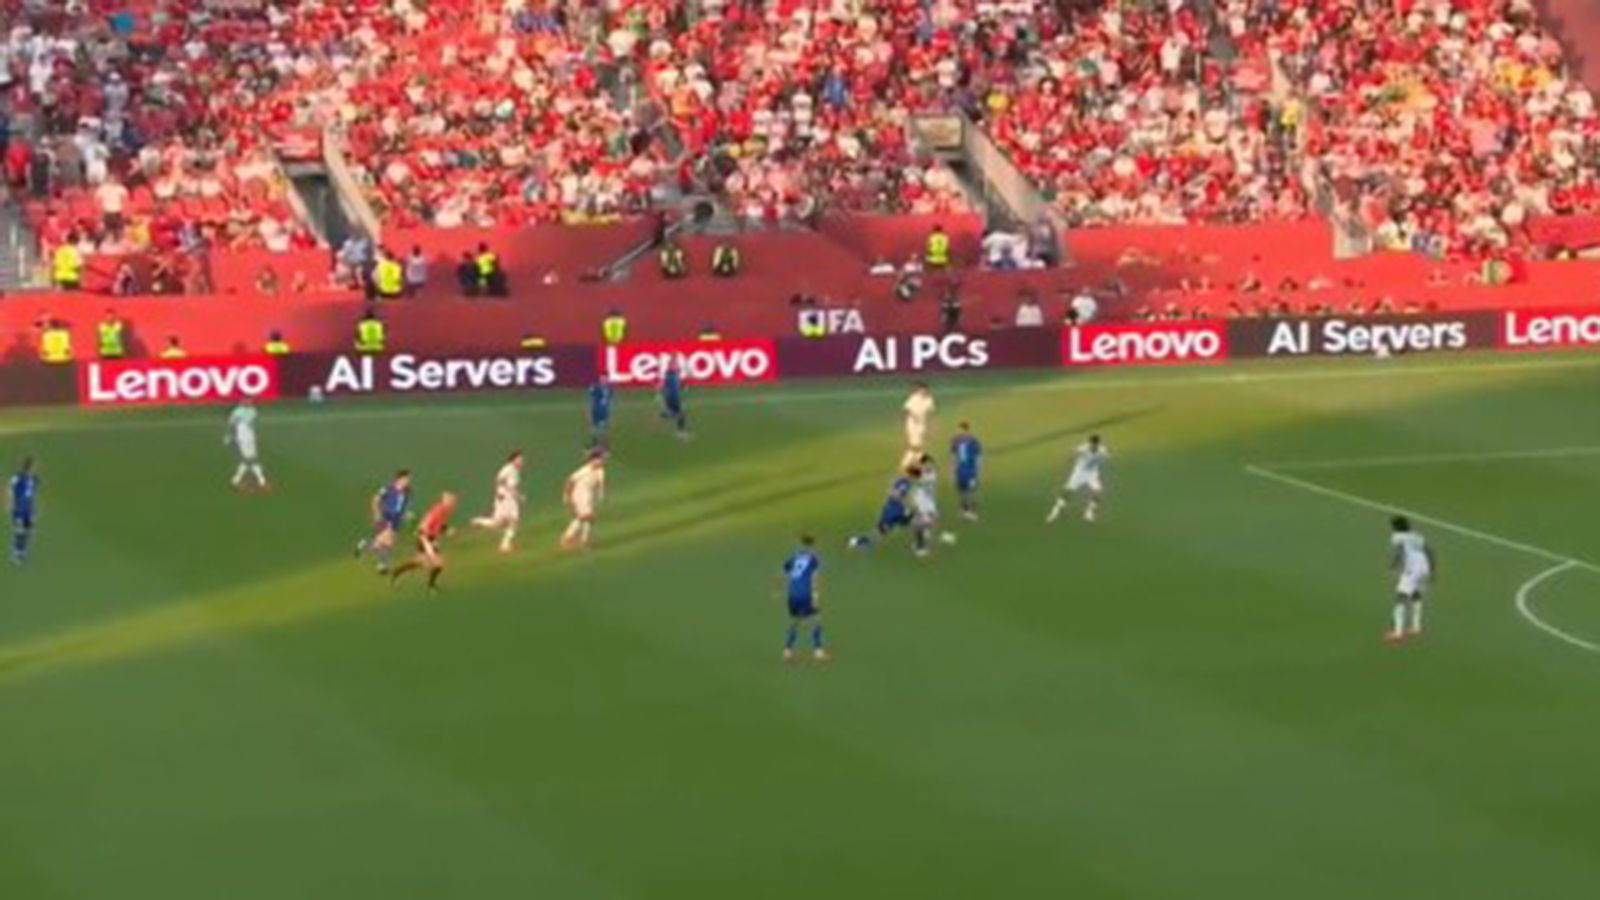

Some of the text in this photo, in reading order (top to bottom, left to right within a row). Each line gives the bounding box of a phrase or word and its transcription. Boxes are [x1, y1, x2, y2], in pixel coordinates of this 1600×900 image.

[853, 333, 988, 371] AI PCs
[1069, 326, 1220, 362] Lenovo
[1267, 319, 1467, 354] AI Servers
[88, 362, 269, 400] Lenovo
[326, 353, 556, 391] AI Servers
